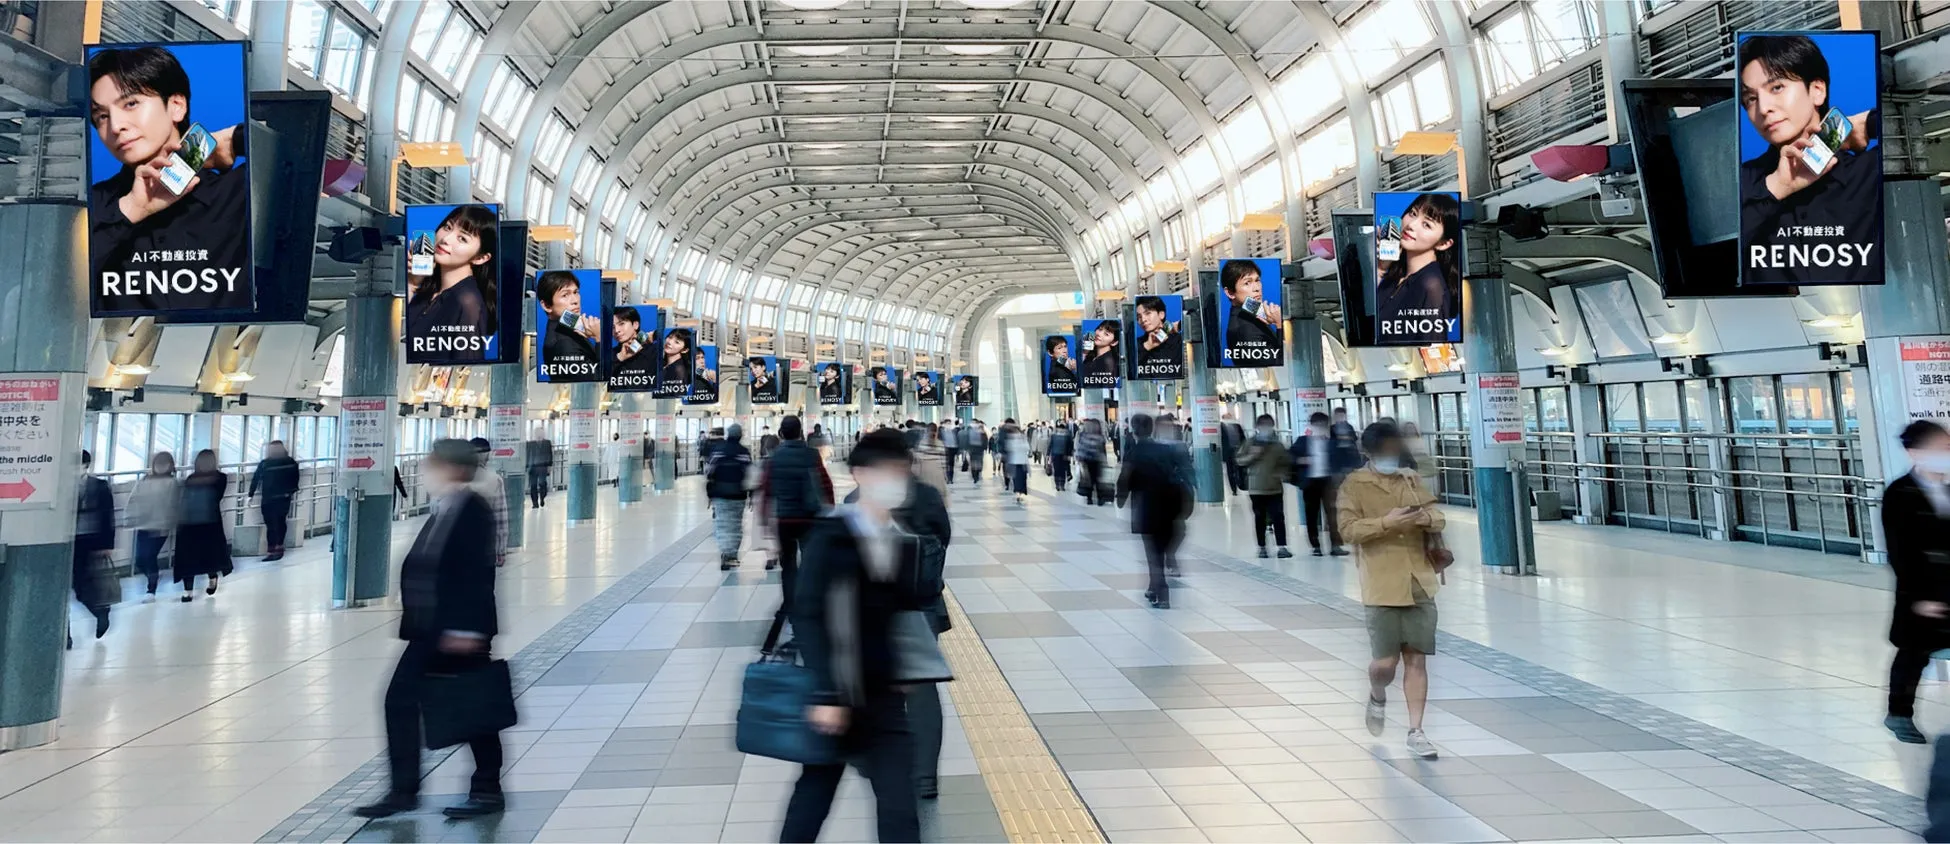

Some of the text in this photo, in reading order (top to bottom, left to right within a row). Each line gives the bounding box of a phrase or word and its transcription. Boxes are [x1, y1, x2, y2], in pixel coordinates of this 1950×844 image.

[1776, 225, 1845, 237] AI不動産投資
[131, 249, 209, 263] AI不動産投資
[1750, 242, 1874, 268] RENOSY
[102, 267, 242, 296] RENOSY
[1381, 318, 1457, 335] RENOSY
[413, 335, 494, 352] RENOSY
[1224, 348, 1280, 360] RENOSY
[540, 363, 598, 375] RENOSY
[1137, 364, 1182, 374] RENOSY
[610, 375, 656, 386] RENOSY
[1047, 382, 1078, 390] RENOSY
[1084, 376, 1120, 384] RENOSY
[1910, 410, 1933, 418] walk
[1936, 410, 1945, 418] in
[0, 414, 41, 427] 中央を
[17, 454, 53, 463] middle
